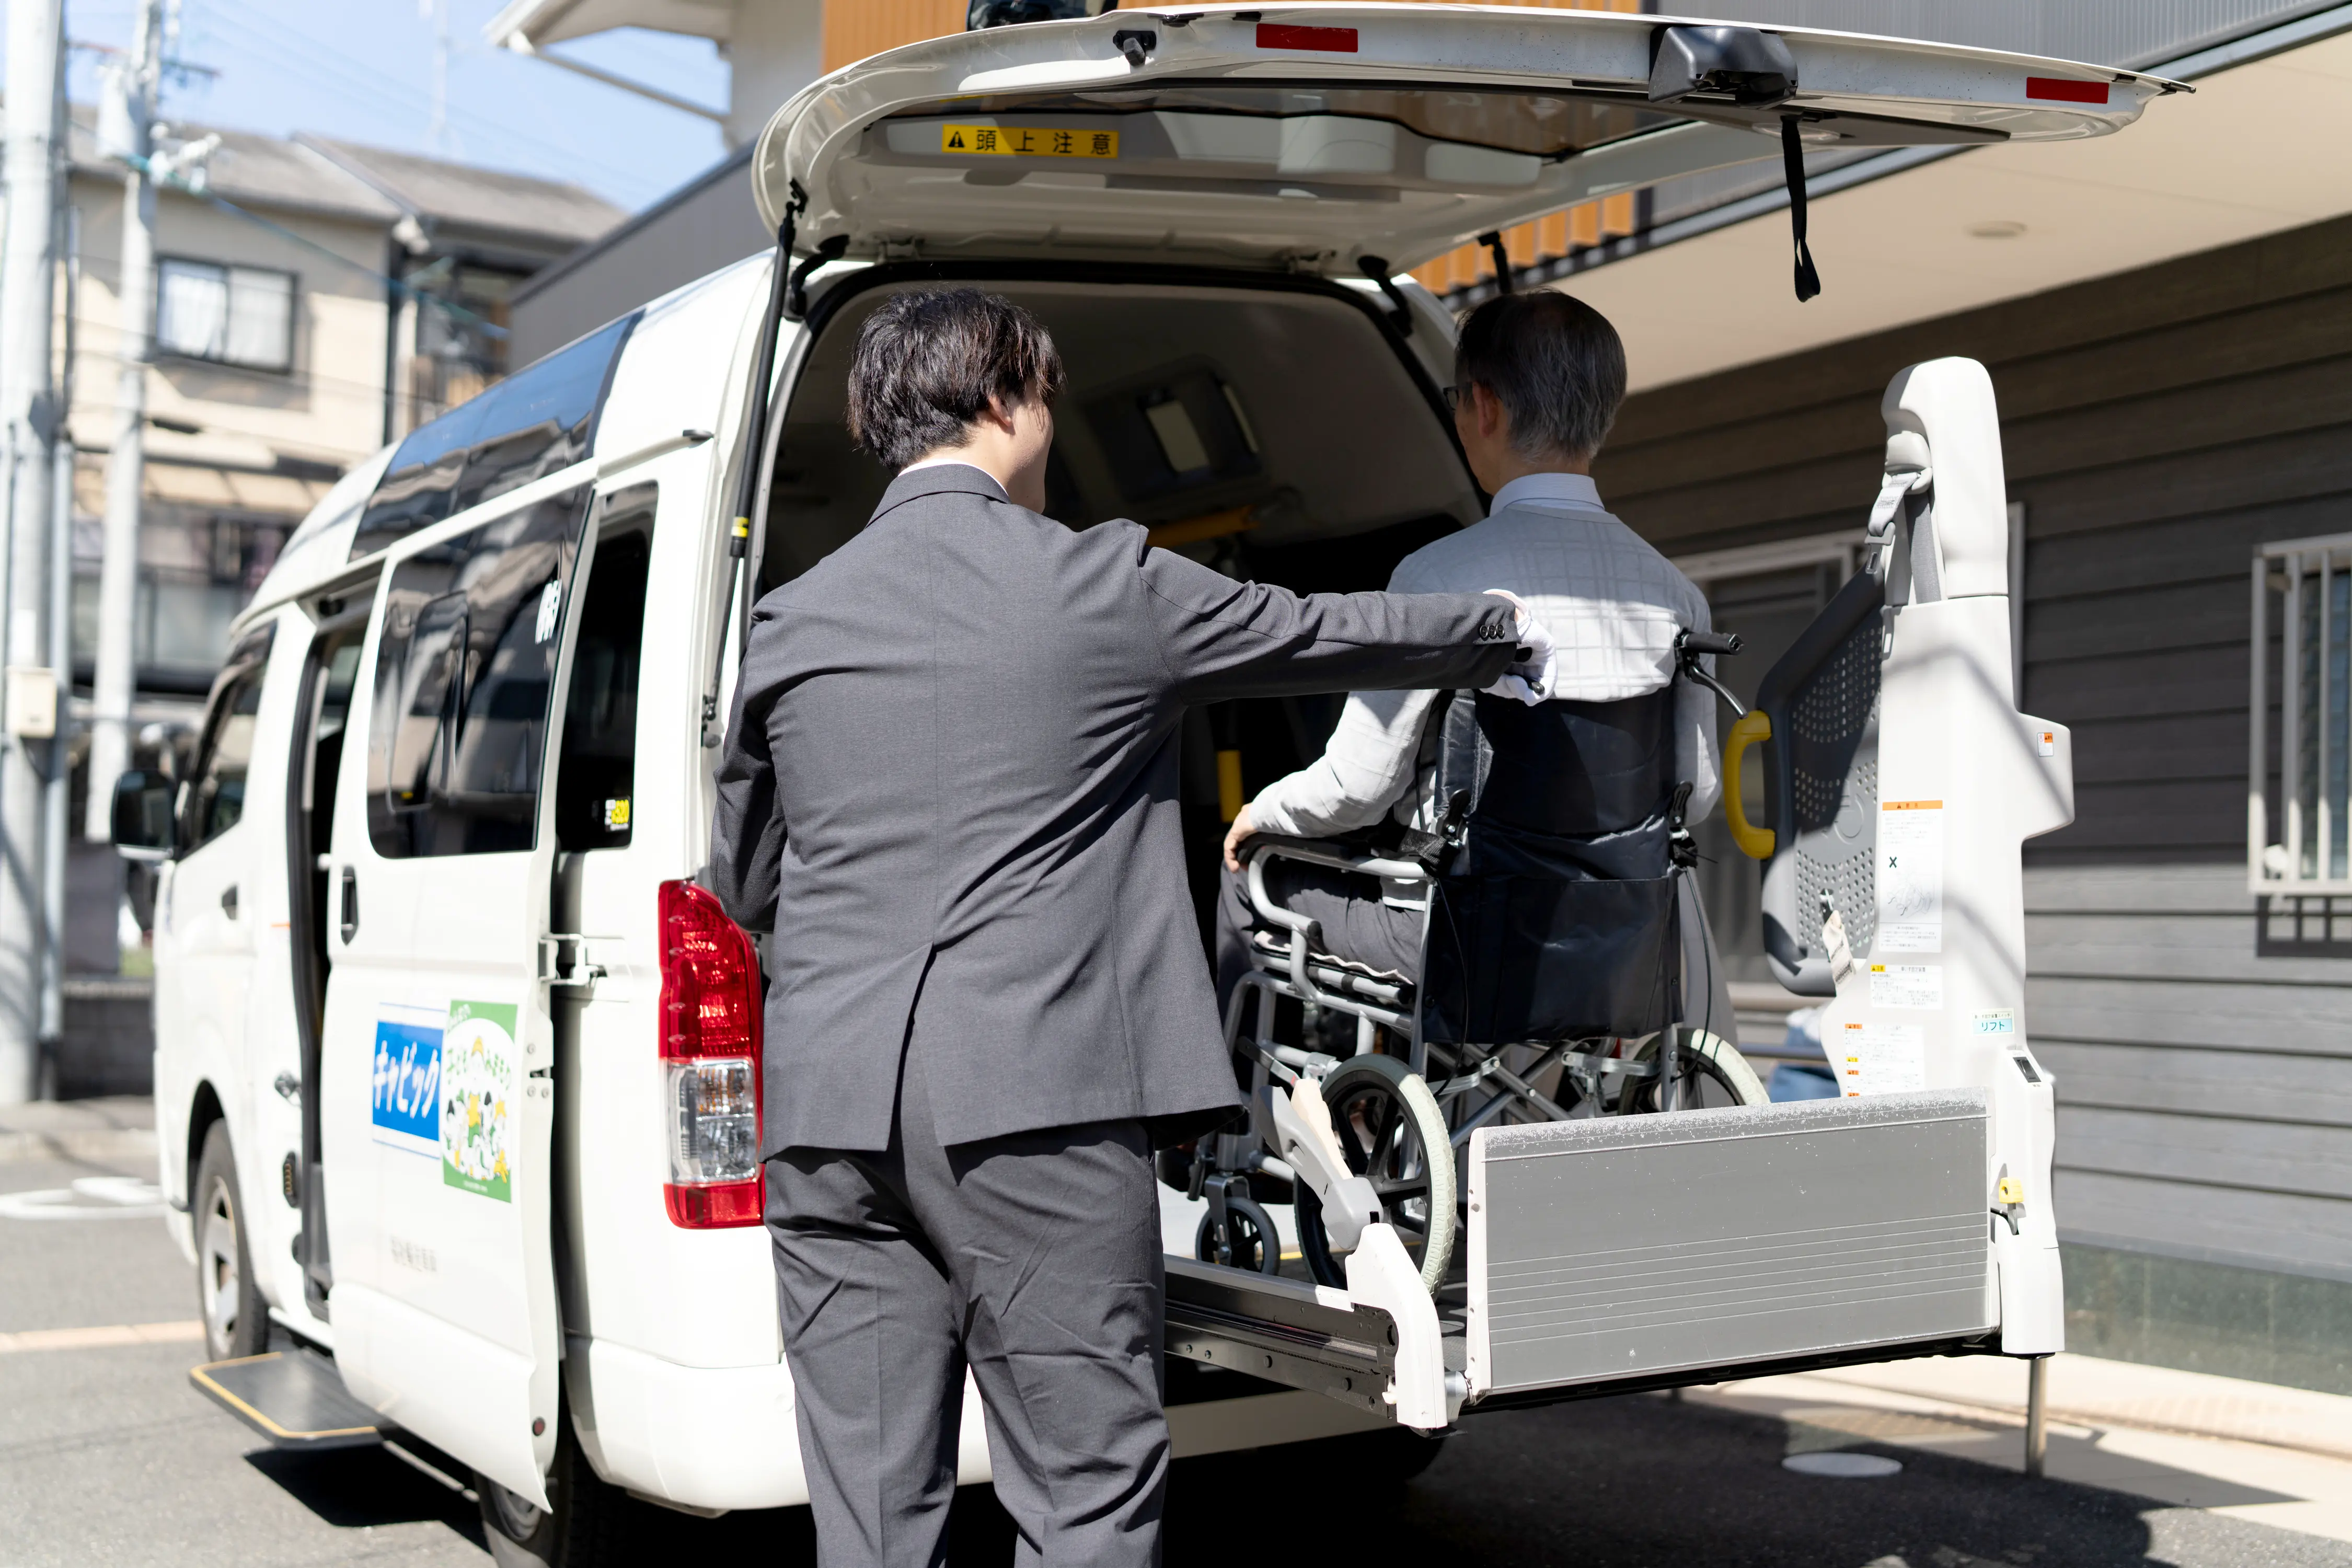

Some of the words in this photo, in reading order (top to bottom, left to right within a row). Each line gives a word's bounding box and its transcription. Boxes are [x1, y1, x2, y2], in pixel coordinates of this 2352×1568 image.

[976, 129, 1111, 155] 頭上注意
[1981, 1021, 2005, 1031] リフト
[373, 1040, 441, 1119] キャビック
